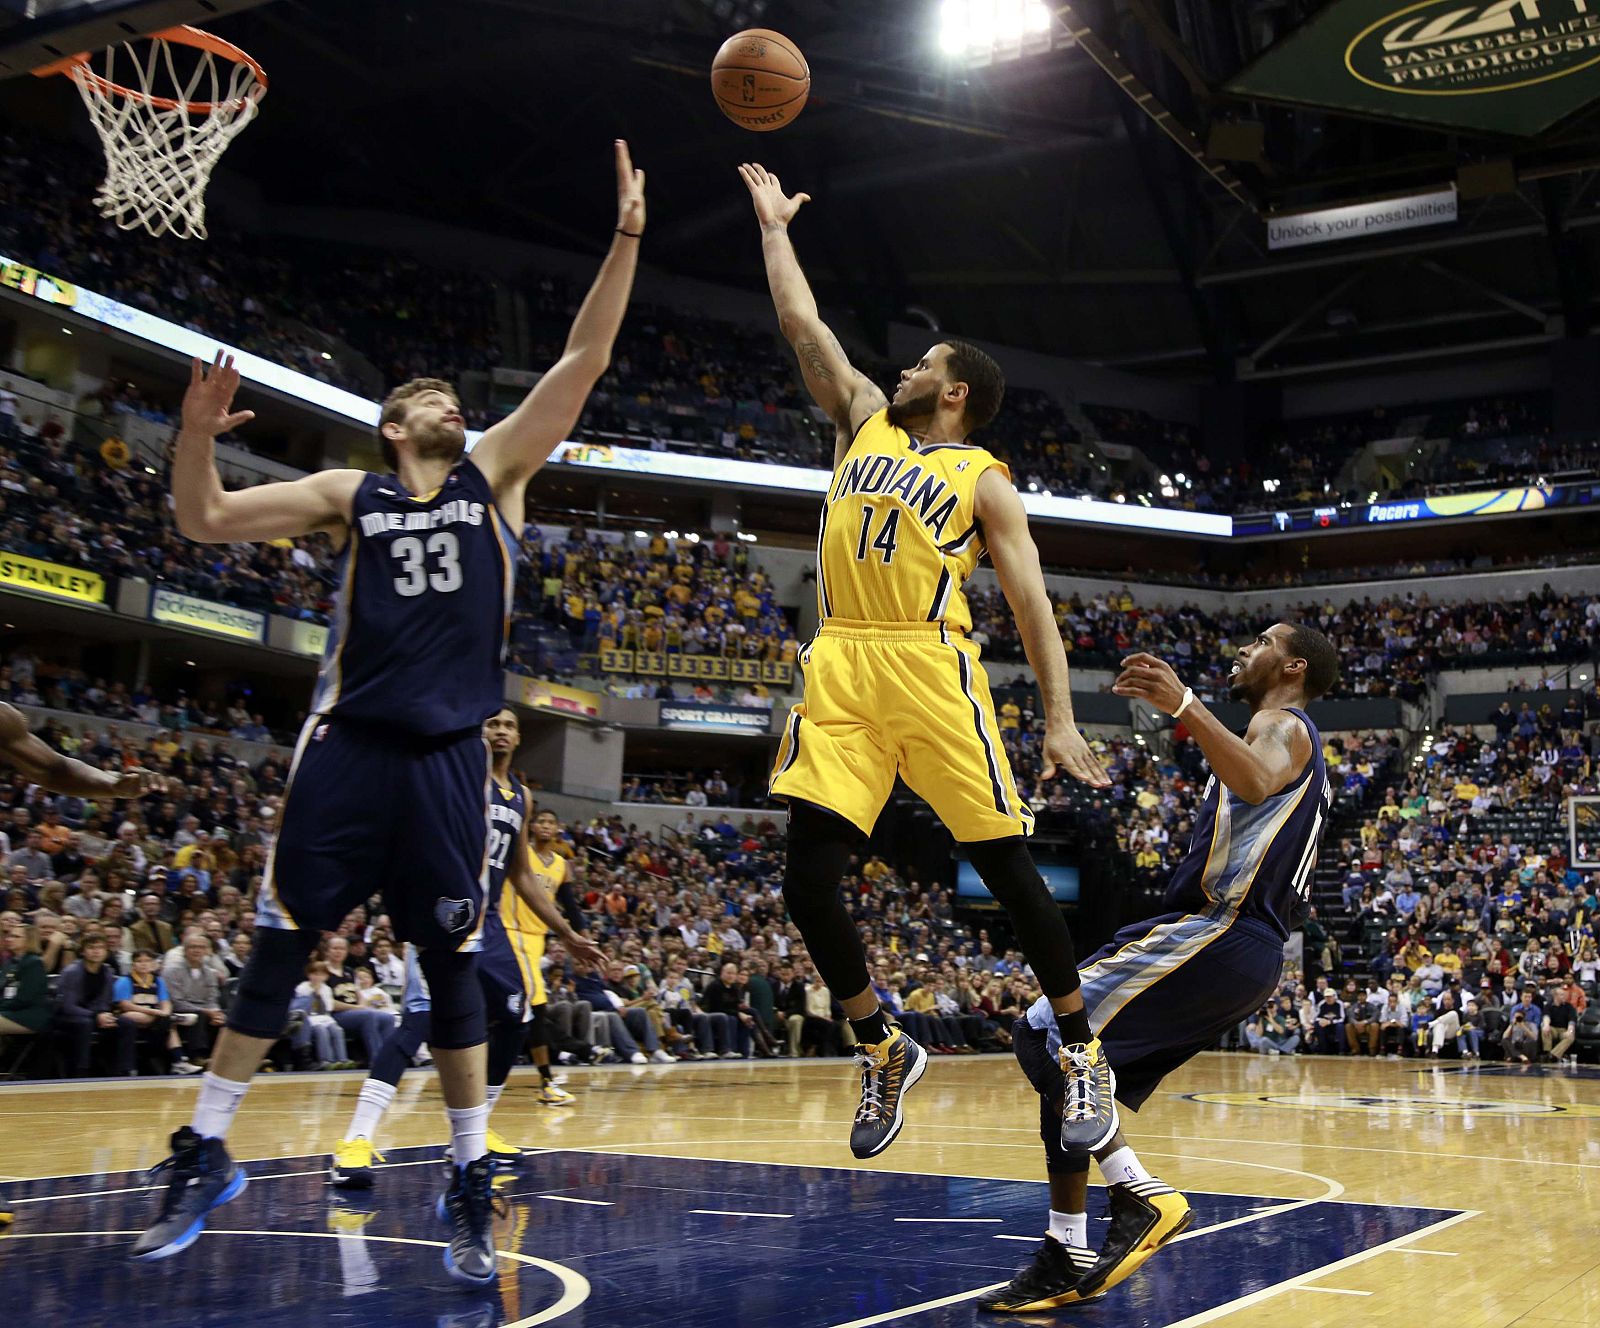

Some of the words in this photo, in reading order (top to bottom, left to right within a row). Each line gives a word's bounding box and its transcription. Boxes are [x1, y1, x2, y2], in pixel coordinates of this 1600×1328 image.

[1381, 28, 1538, 68] BANKERS
[1542, 14, 1600, 38] LIFE
[1390, 33, 1600, 84] FIELDHOUSE
[1450, 58, 1554, 83] INDIANAPOLIS
[721, 103, 785, 125] SPALD
[1269, 221, 1323, 242] Unlock
[1326, 217, 1360, 234] your
[1364, 200, 1456, 231] possibilities
[359, 499, 486, 538] MEMPHIS
[832, 453, 959, 545] INDIANA
[856, 504, 901, 565] 14
[1, 560, 97, 595] STANLEY
[389, 531, 464, 598] 33
[661, 707, 704, 723] SPORT
[705, 709, 769, 726] GRAPHICS
